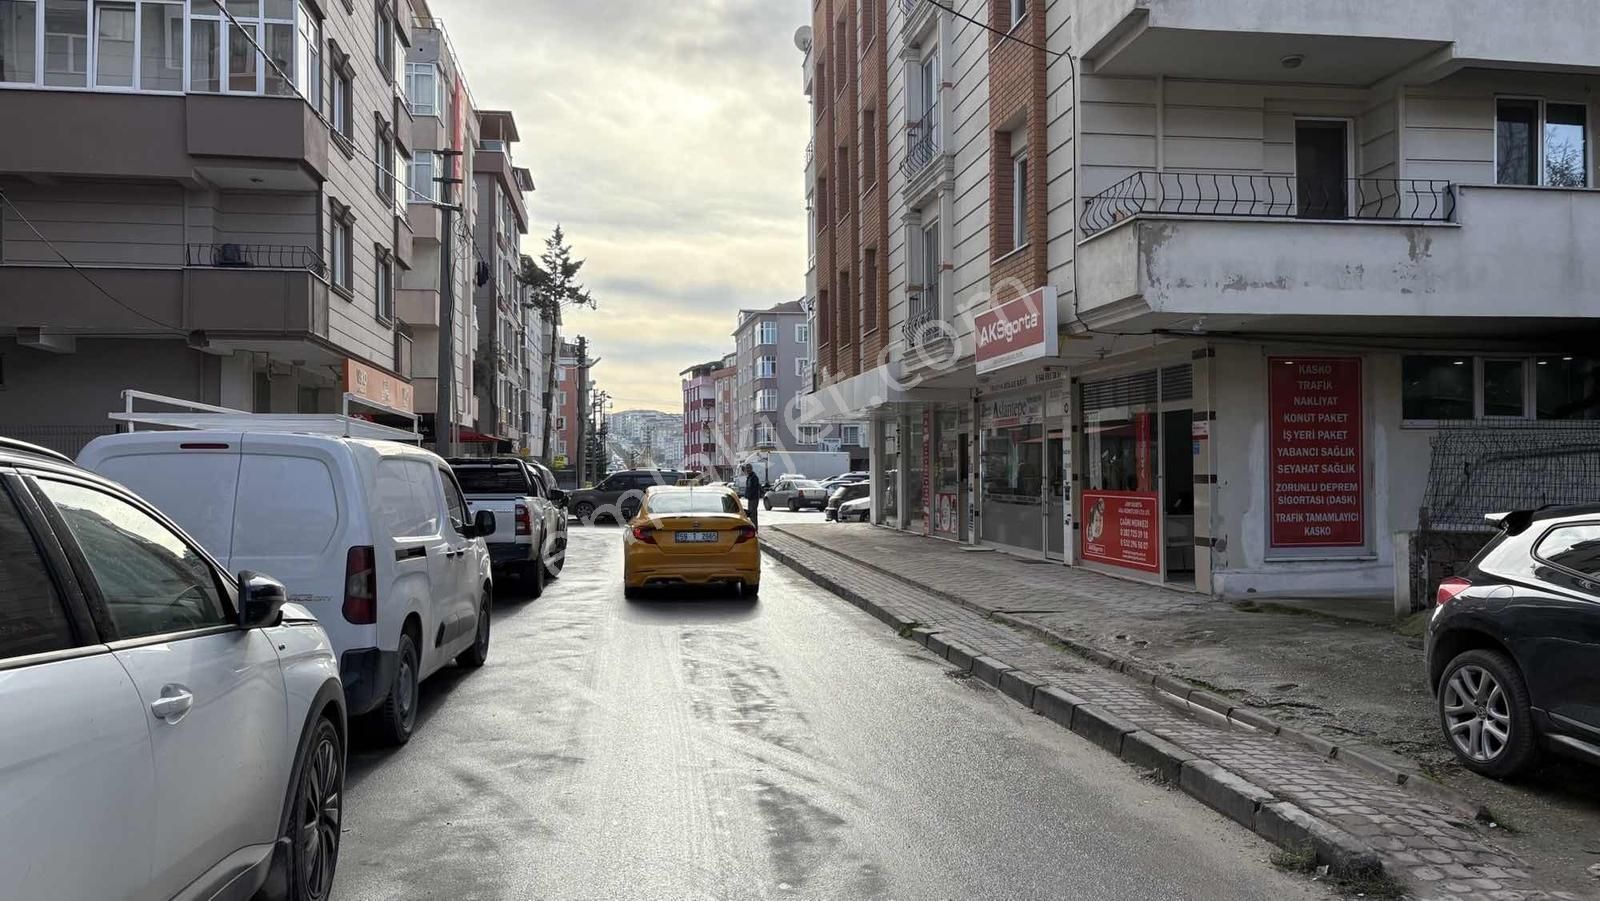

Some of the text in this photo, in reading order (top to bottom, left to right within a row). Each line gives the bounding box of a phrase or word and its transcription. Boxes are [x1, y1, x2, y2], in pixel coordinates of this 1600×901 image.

[1299, 364, 1332, 374] KASKO
[1283, 413, 1348, 423] KONUT PAKET
[1283, 428, 1348, 441] İŞ YERİ PAKET
[1277, 445, 1355, 457] YABANCI SAĞLIK
[1277, 462, 1355, 474] SEYAHAT SAĞLIK
[1275, 482, 1358, 492] ZORUNLU DEPREM
[1278, 495, 1356, 506] SİGORTASI (DASK)
[1276, 511, 1359, 522] TRAFİK TAMAMLAYICI
[1304, 526, 1331, 536] KASKO
